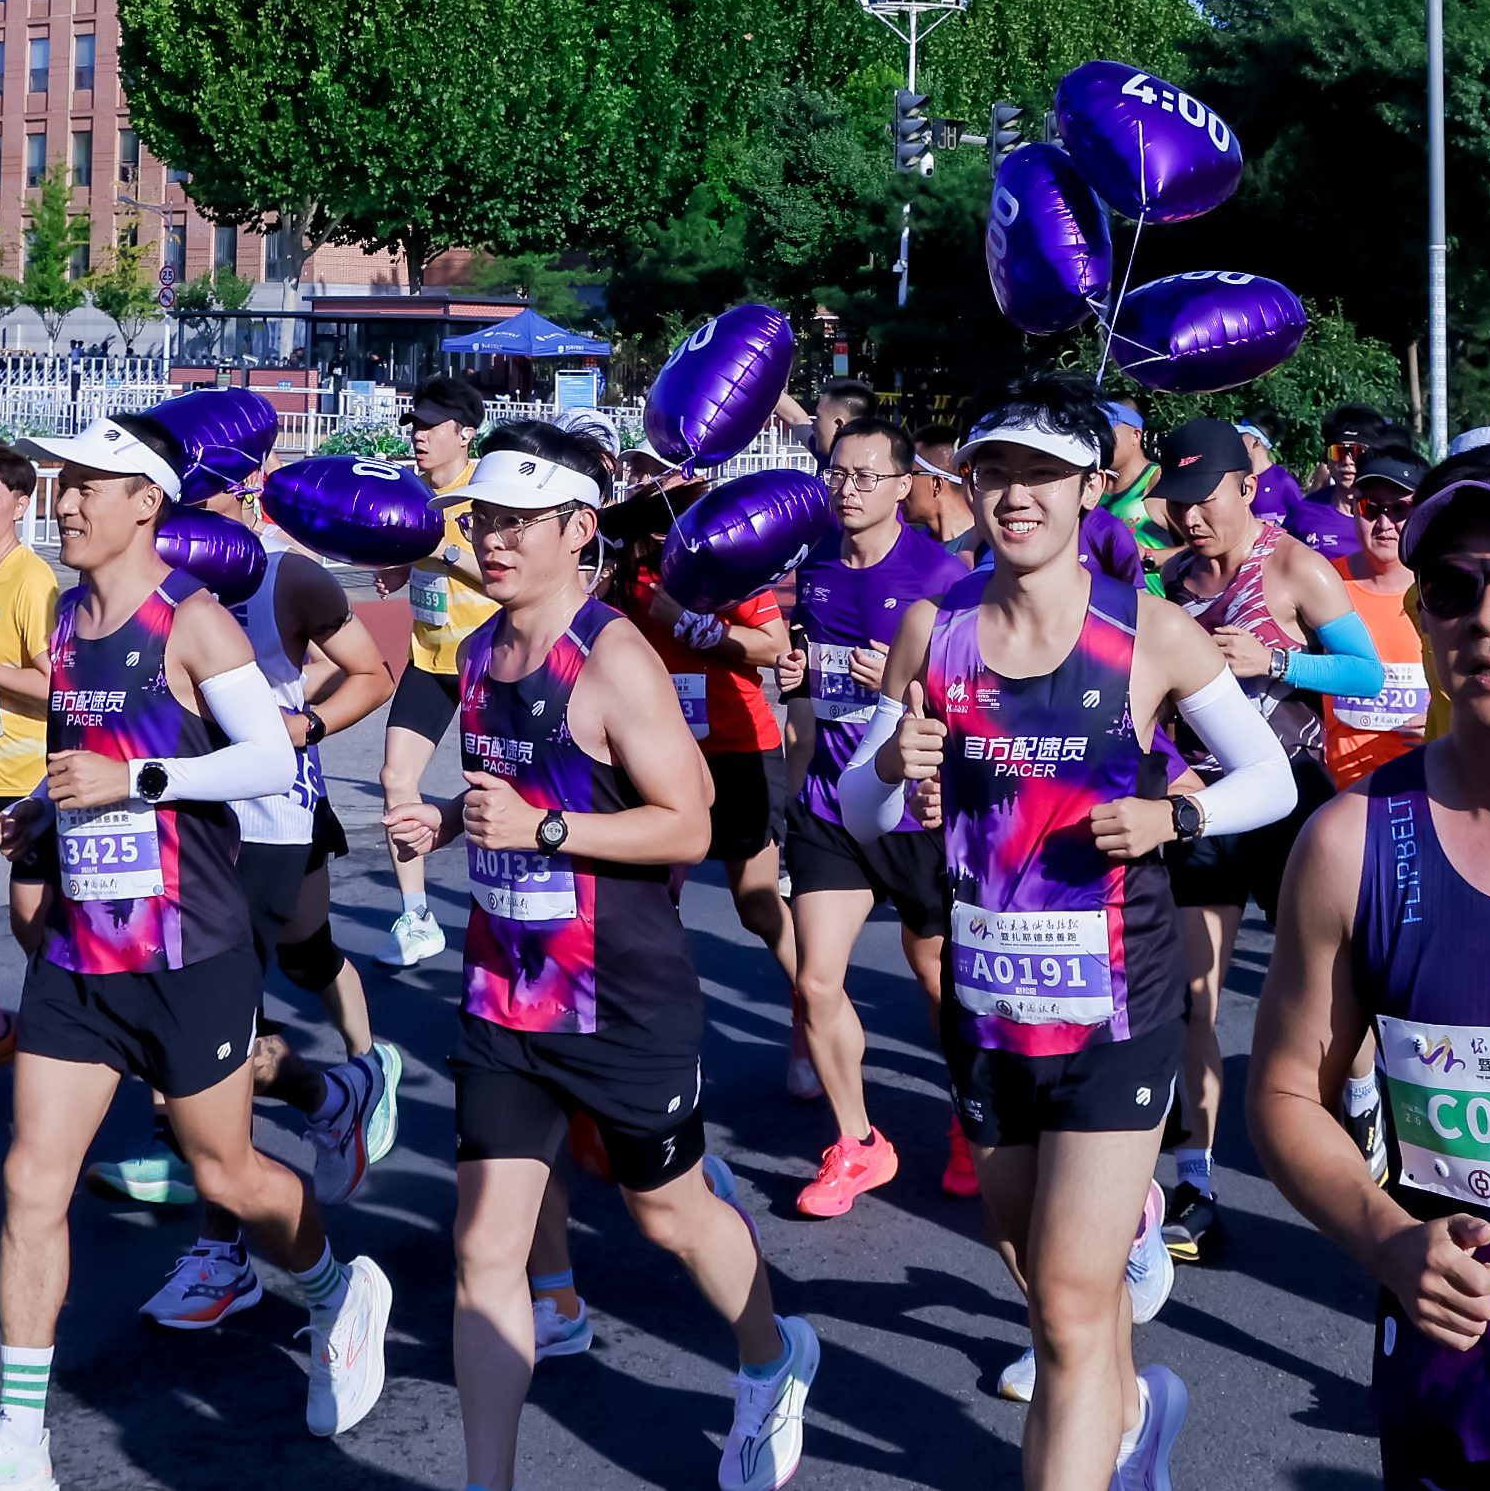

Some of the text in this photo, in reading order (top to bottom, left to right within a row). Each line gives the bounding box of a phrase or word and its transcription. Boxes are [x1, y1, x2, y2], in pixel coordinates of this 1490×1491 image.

[1121, 73, 1230, 152] 4:00
[51, 690, 127, 713] 官方配速员
[66, 713, 103, 727] PACER
[465, 732, 534, 764] 官方配速员
[964, 736, 1088, 761] 官方配速员
[483, 759, 517, 777] PACER
[994, 763, 1057, 778] PACER
[972, 952, 1087, 988] A0191
